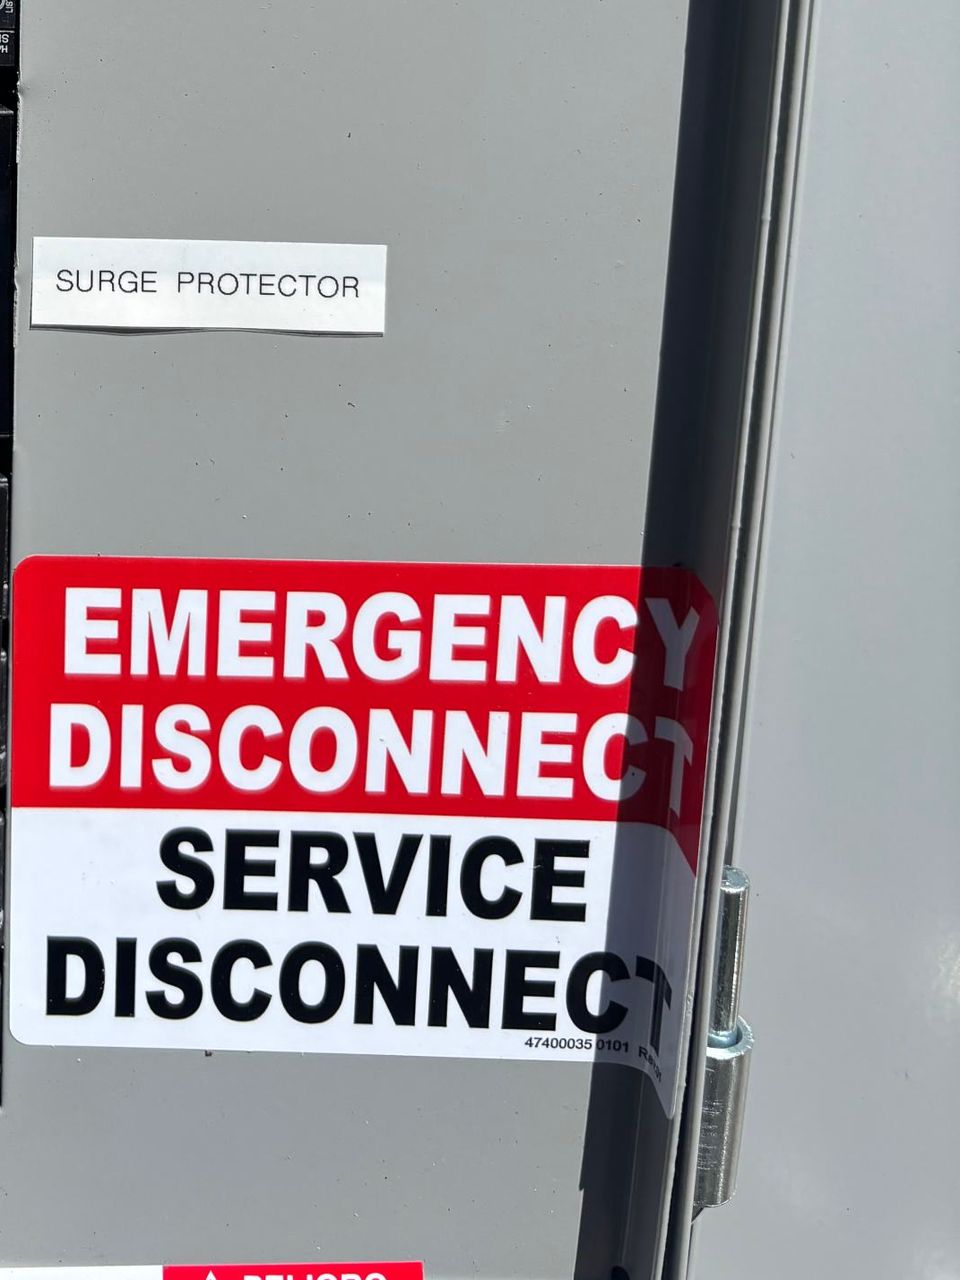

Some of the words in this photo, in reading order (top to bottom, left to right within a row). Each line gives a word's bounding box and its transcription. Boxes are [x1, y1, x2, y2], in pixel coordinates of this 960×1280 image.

[56, 269, 157, 293] SURGE
[178, 272, 360, 299] PROTECTOR
[63, 587, 700, 691] EMERGENCY
[47, 703, 694, 816] DISCONNECT
[155, 826, 591, 922] SERVICE
[45, 936, 674, 1057] DISCONNECT
[524, 1037, 592, 1050] 47400035
[595, 1039, 629, 1052] 0101
